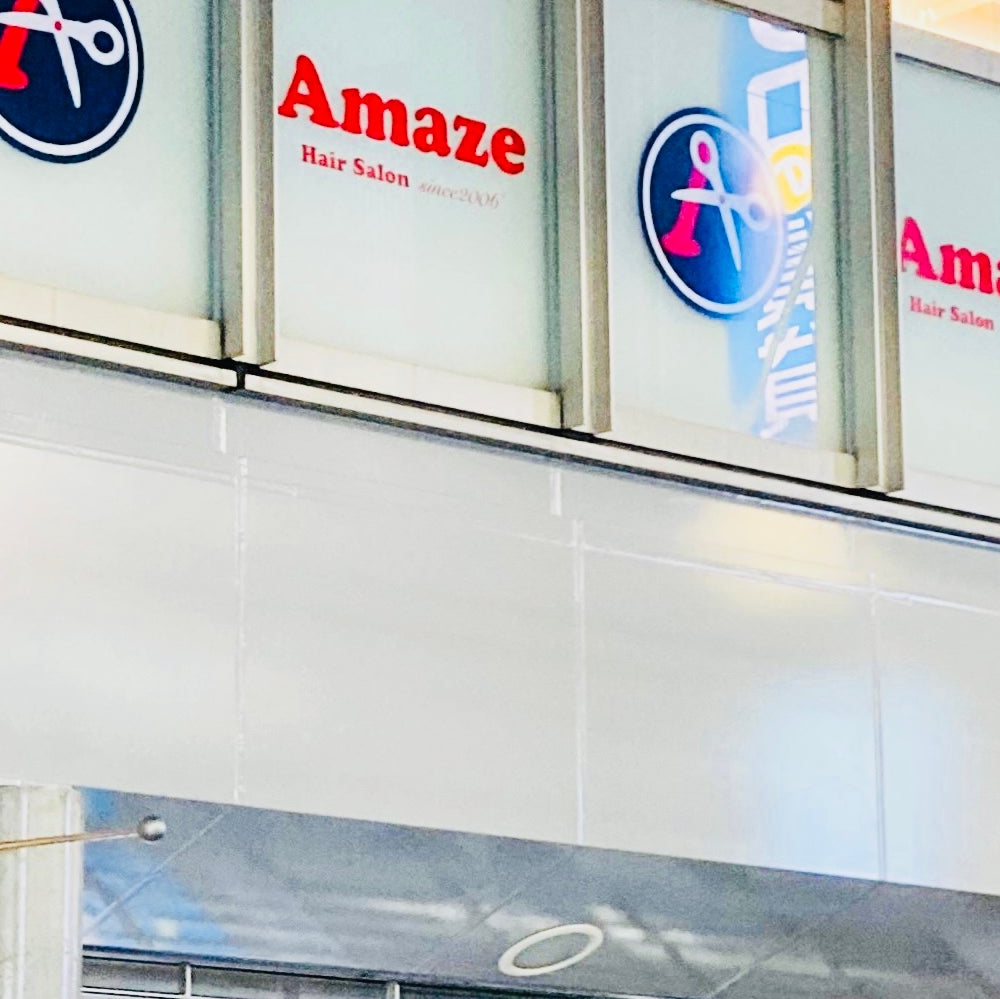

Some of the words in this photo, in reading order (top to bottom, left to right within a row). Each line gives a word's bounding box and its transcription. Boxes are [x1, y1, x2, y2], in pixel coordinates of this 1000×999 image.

[277, 55, 526, 174] Amaze
[301, 144, 347, 172] Hair
[353, 158, 410, 188] Salon
[909, 296, 946, 319] Hair
[950, 306, 995, 331] Salon
